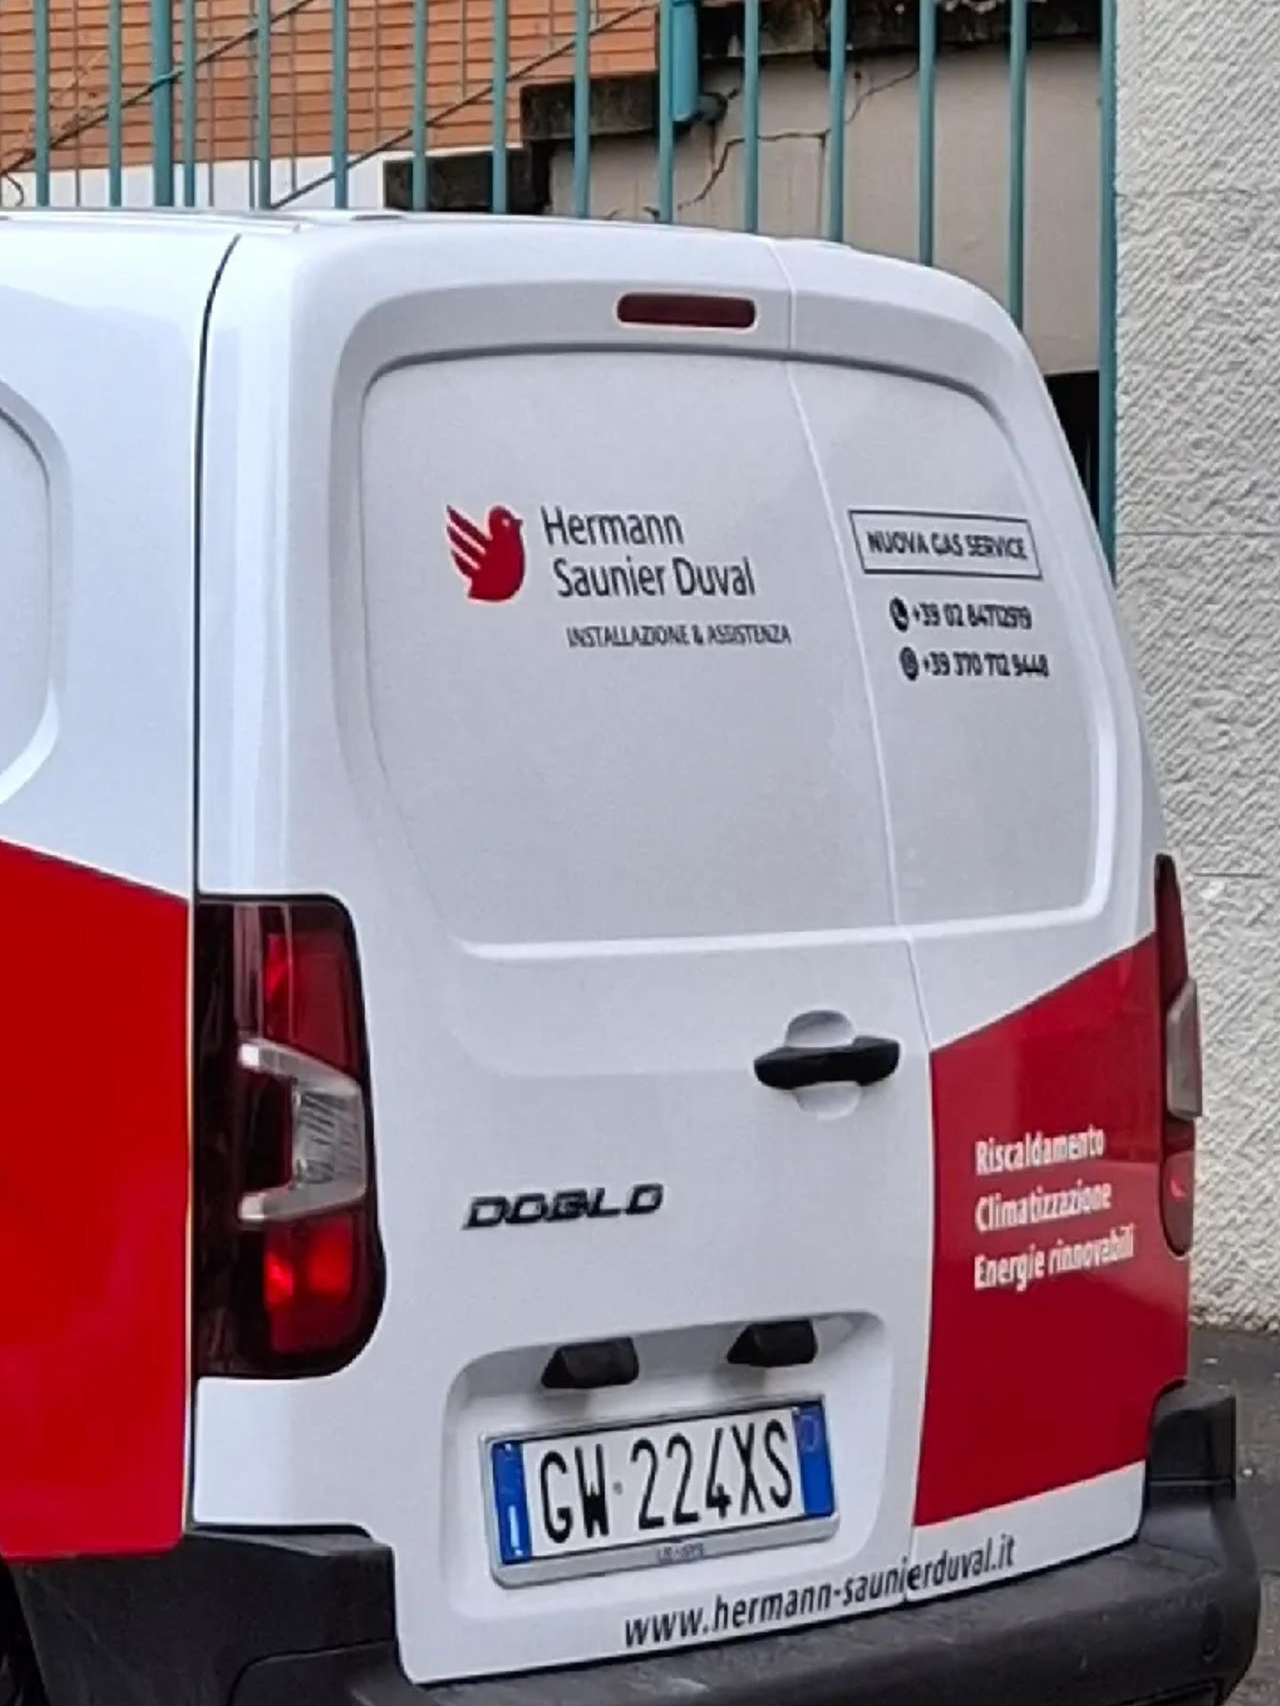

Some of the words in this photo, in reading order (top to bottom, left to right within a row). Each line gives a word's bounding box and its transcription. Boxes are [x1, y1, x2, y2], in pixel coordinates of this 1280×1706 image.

[540, 505, 685, 545] Hermann
[866, 529, 930, 554] NUOVA
[964, 534, 1029, 560] SERVICE
[553, 554, 666, 597] Saunier
[671, 555, 757, 597] Duval
[566, 625, 690, 648] INSTALLAZIONE
[692, 625, 705, 645] &
[707, 623, 792, 646] ASSISTENZA
[975, 1123, 1106, 1177] Riscaldamento
[461, 1183, 665, 1231] DOBLO
[975, 1177, 1113, 1233] Climatizzazione
[974, 1243, 1045, 1293] Energie
[1047, 1222, 1136, 1276] rinnovabili
[539, 1443, 610, 1544] GW
[630, 1418, 793, 1530] 224XS
[623, 1534, 1017, 1649] www.hermann-saunierduval.it
